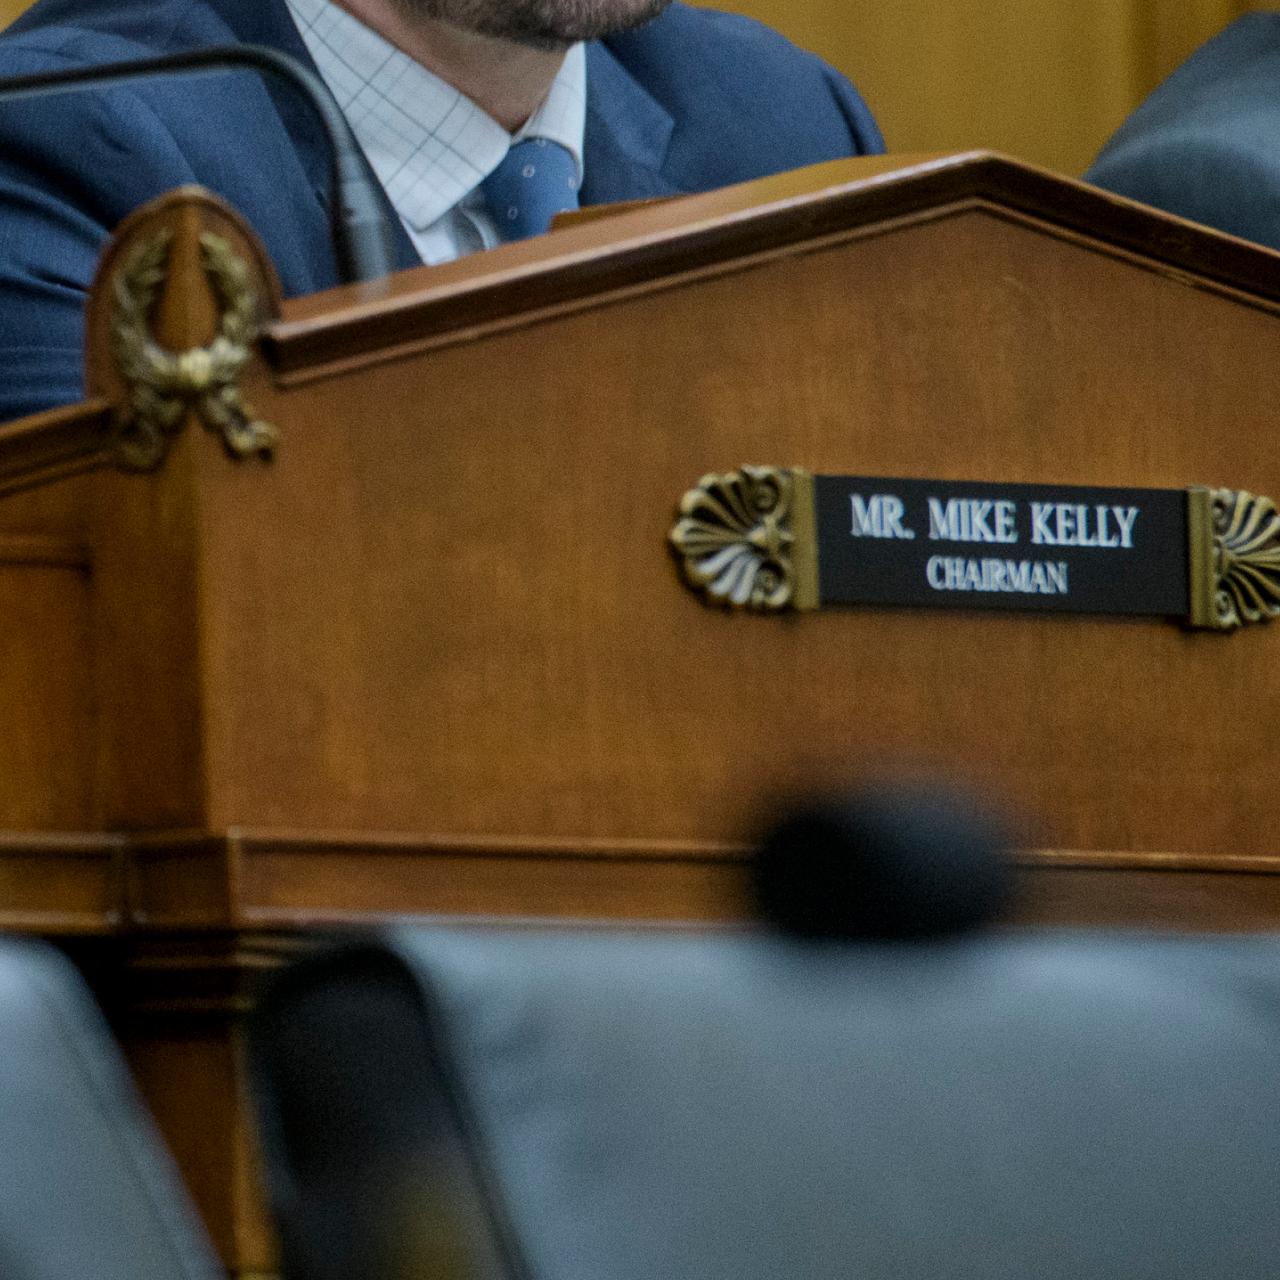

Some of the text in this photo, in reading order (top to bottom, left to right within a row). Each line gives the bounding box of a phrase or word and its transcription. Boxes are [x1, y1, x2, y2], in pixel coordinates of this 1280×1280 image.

[850, 494, 1139, 548] MR. MIKE KELLY
[926, 555, 1069, 594] CHAIRMAN
